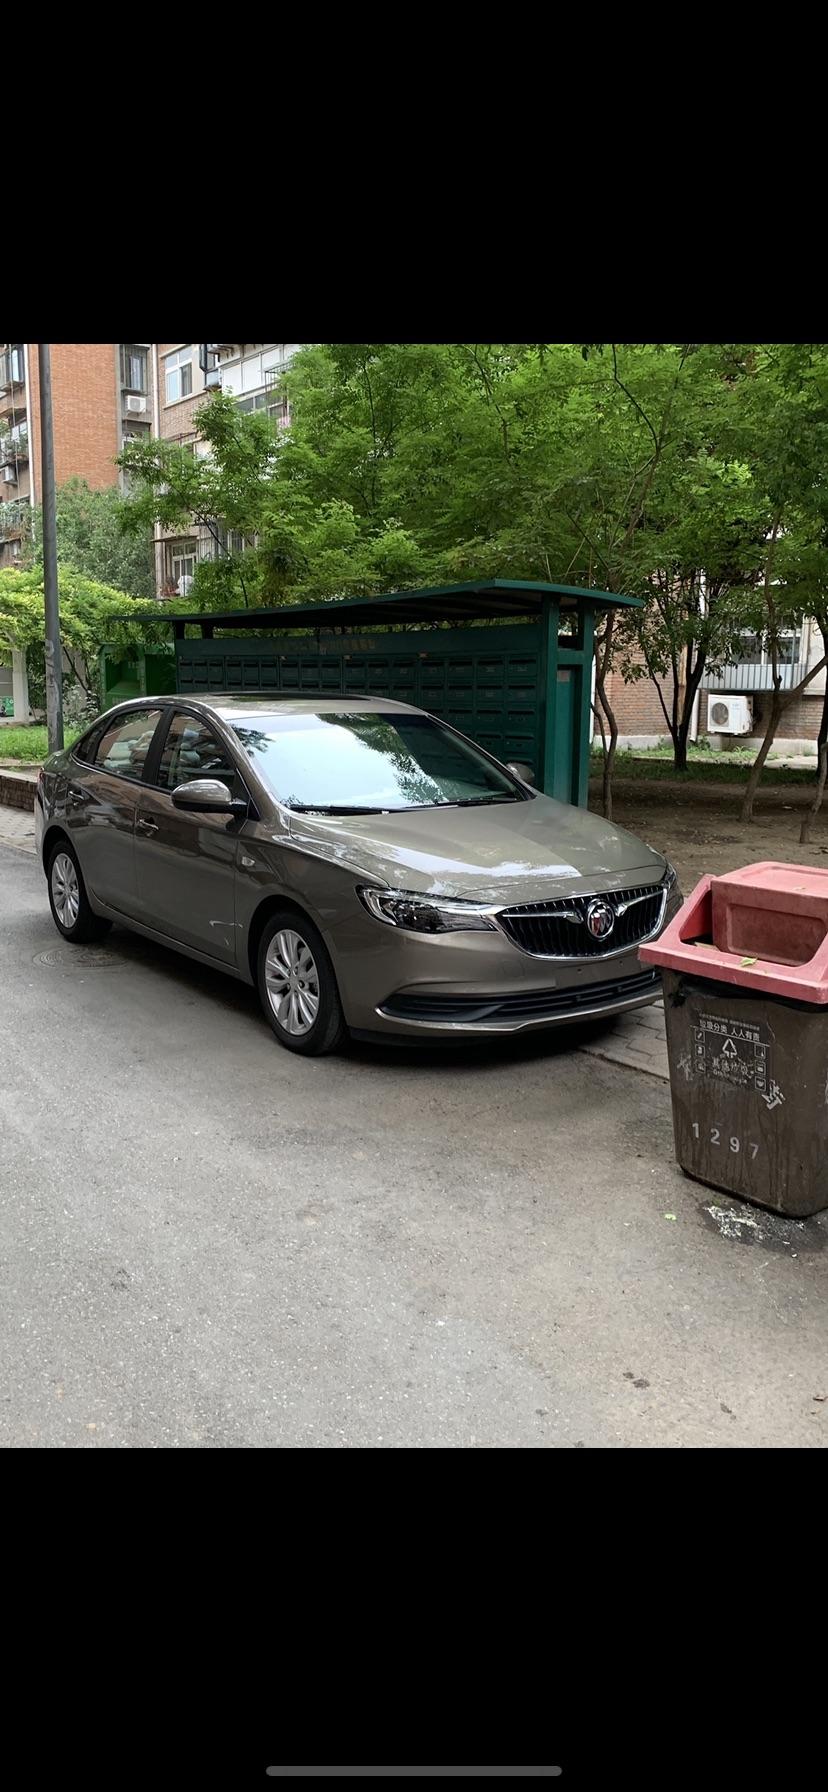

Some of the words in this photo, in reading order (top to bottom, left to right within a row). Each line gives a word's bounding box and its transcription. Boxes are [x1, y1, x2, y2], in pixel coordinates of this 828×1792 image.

[730, 1027, 760, 1042] 人人有责
[692, 1122, 759, 1160] 1297
